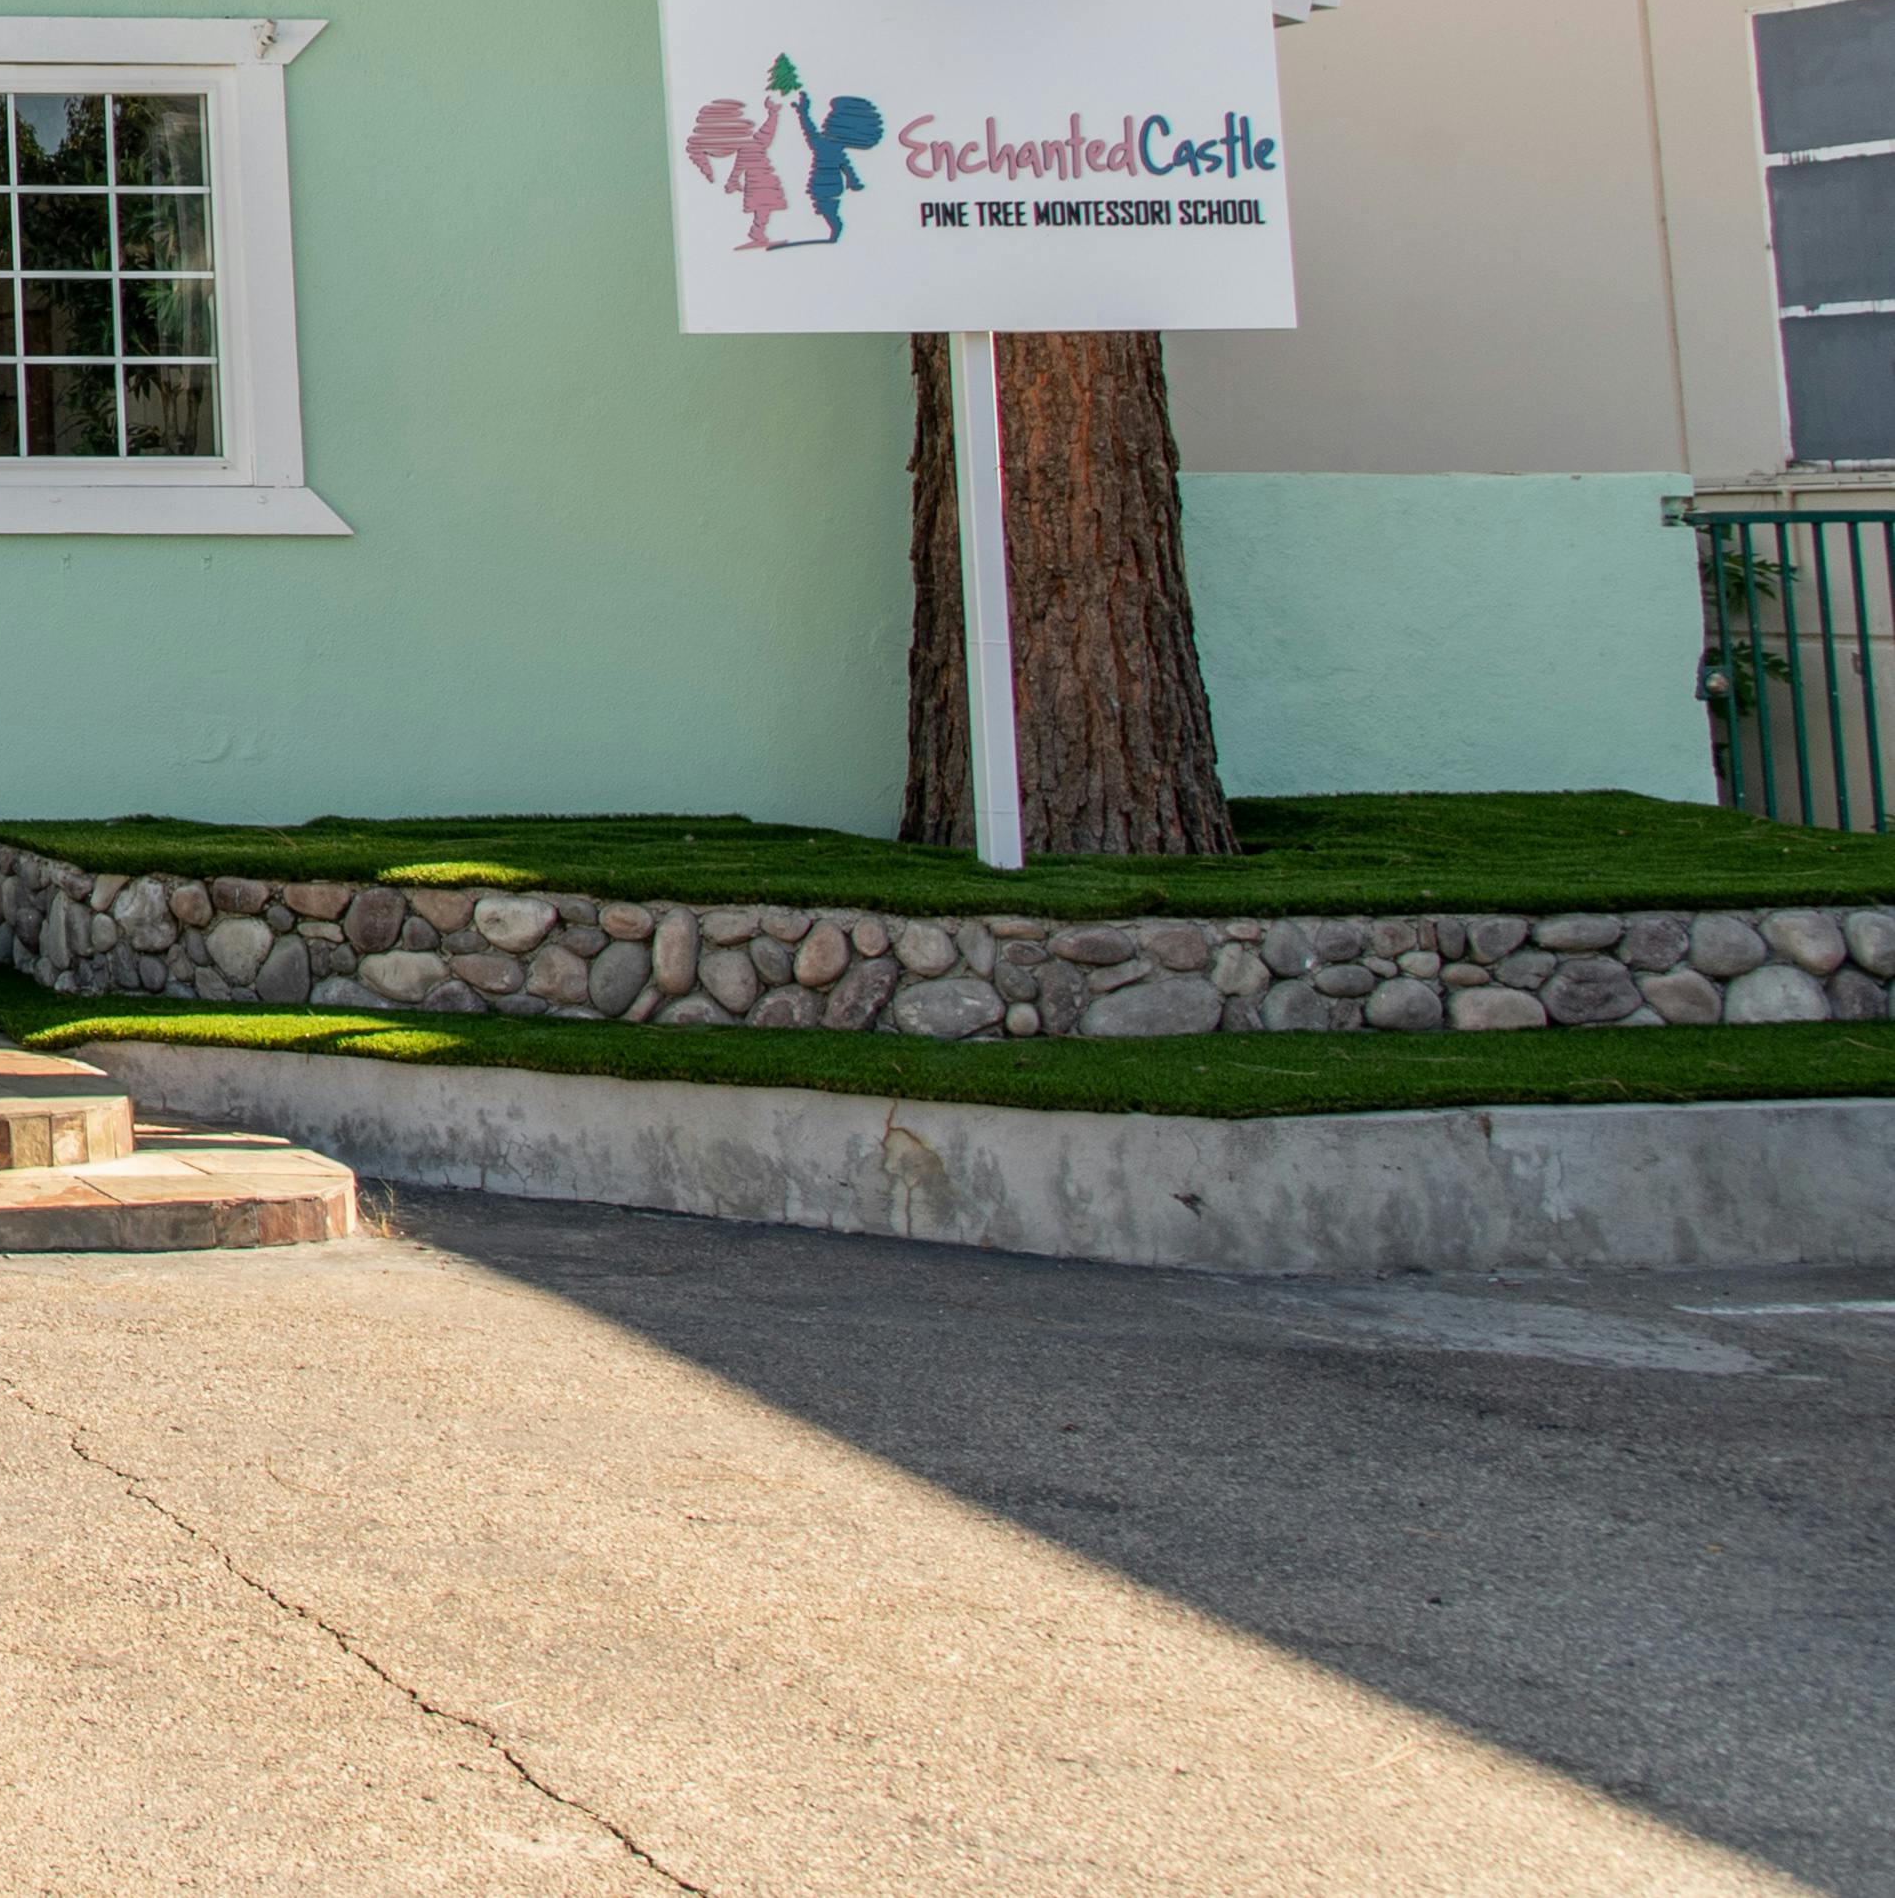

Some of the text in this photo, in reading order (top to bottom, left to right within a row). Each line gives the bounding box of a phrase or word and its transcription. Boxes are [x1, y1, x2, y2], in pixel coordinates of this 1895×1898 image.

[920, 198, 1267, 228] PINE TREE MONTESSORI SCHOOL
